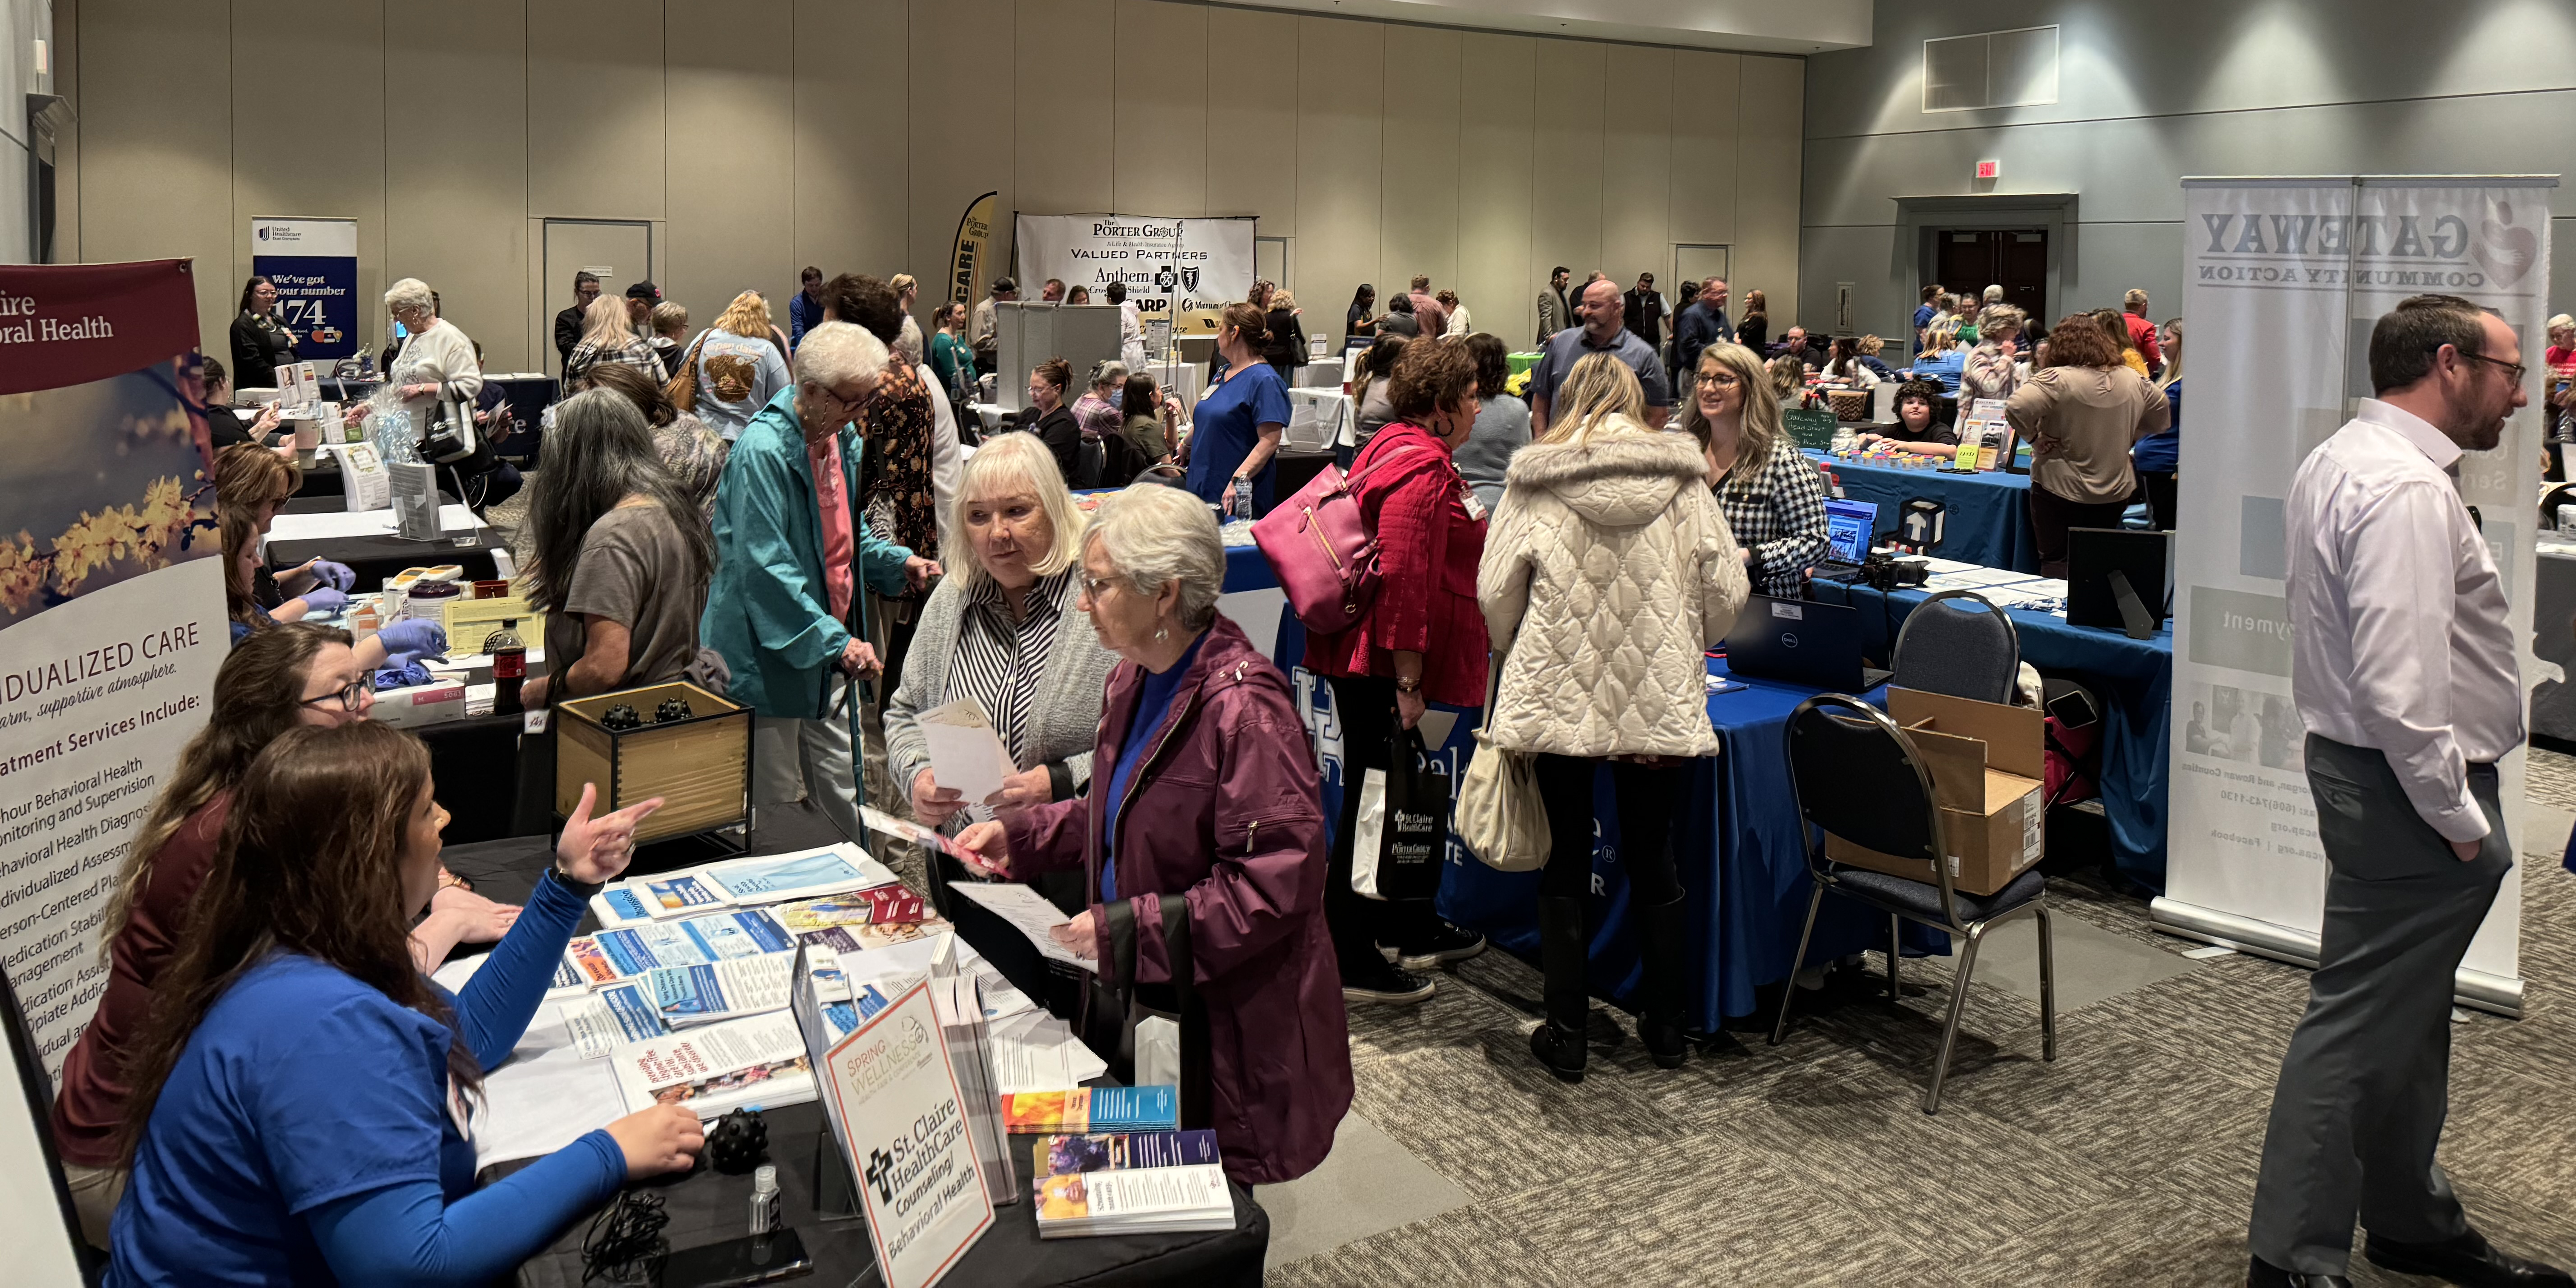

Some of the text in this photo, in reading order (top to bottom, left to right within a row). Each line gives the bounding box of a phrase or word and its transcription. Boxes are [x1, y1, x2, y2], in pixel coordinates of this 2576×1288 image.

[966, 218, 988, 230] PORTER
[1093, 224, 1140, 236] PORTER
[1071, 249, 1207, 260] VALUED PARTNERS
[272, 275, 325, 286] We've got
[300, 286, 345, 296] number
[1095, 267, 1149, 282] Anthem
[273, 299, 327, 325] 174
[1136, 299, 1167, 312] ARP
[40, 316, 114, 341] Health
[143, 622, 199, 659] CARE
[37, 685, 103, 719] supportive
[107, 662, 177, 695] atmosphere.
[68, 718, 136, 752] Services
[140, 694, 200, 726] Include:
[35, 771, 101, 810] Behavioral
[104, 757, 143, 783] Health
[59, 799, 83, 822] and
[85, 775, 155, 812] Supervision
[56, 824, 98, 853] Health
[847, 1039, 886, 1077] SPRING
[851, 1034, 917, 1095] WELLNESS
[893, 1098, 956, 1163] St. Claire
[890, 1119, 963, 1195] HealthCare
[896, 1149, 954, 1218] Counseling/
[888, 1164, 975, 1261] Behavioral Health
